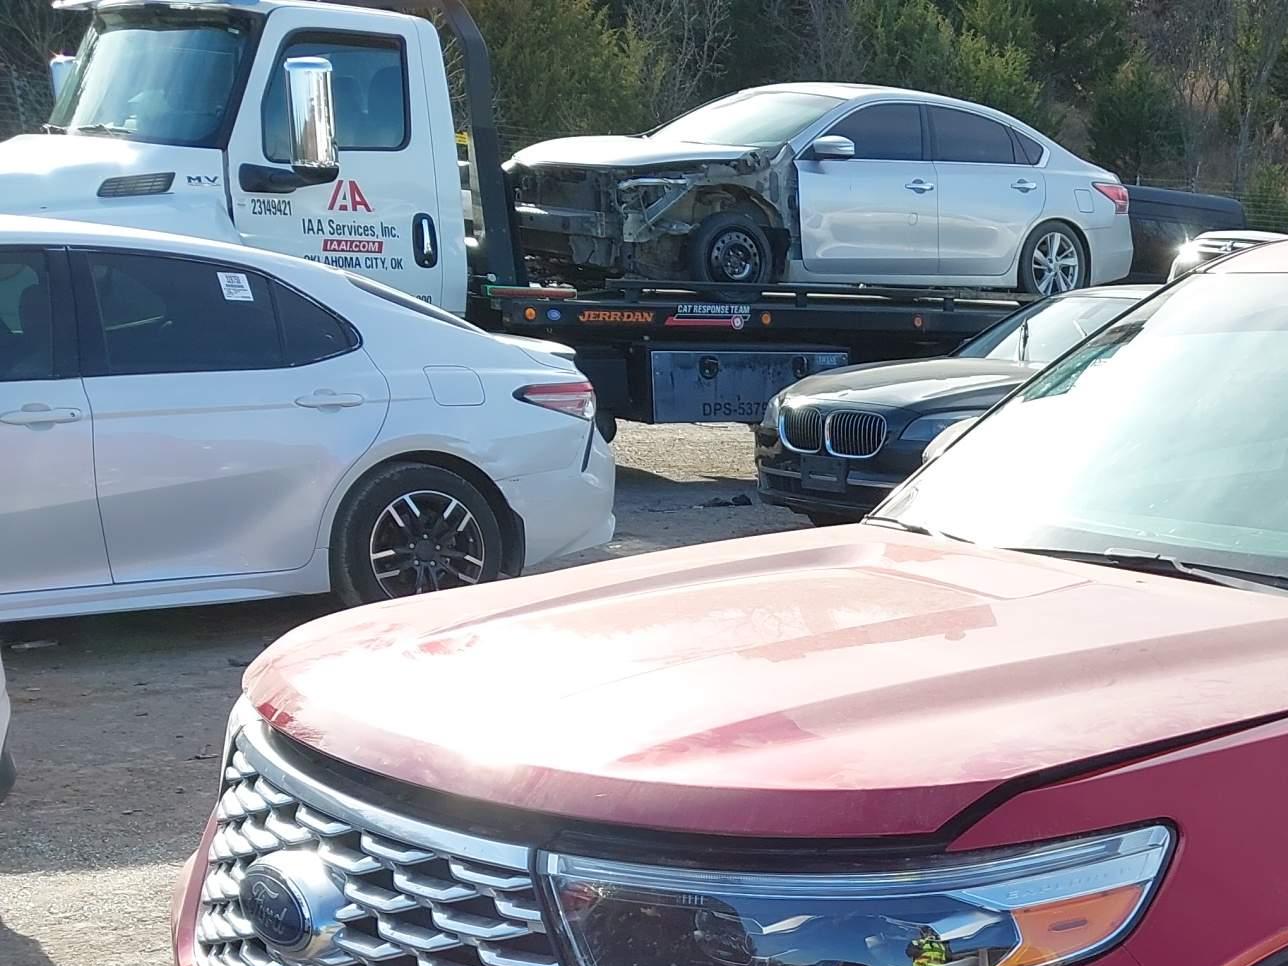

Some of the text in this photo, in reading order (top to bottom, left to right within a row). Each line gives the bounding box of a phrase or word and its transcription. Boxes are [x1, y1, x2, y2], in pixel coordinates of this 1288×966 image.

[186, 175, 218, 183] MV
[251, 198, 293, 216] 23149421
[302, 218, 400, 239] IAA Services, Inc.
[326, 240, 380, 252] IAAI.COM
[364, 256, 388, 271] CITY,
[390, 257, 404, 270] OK
[677, 304, 751, 314] CAT RESPONSE TEAM
